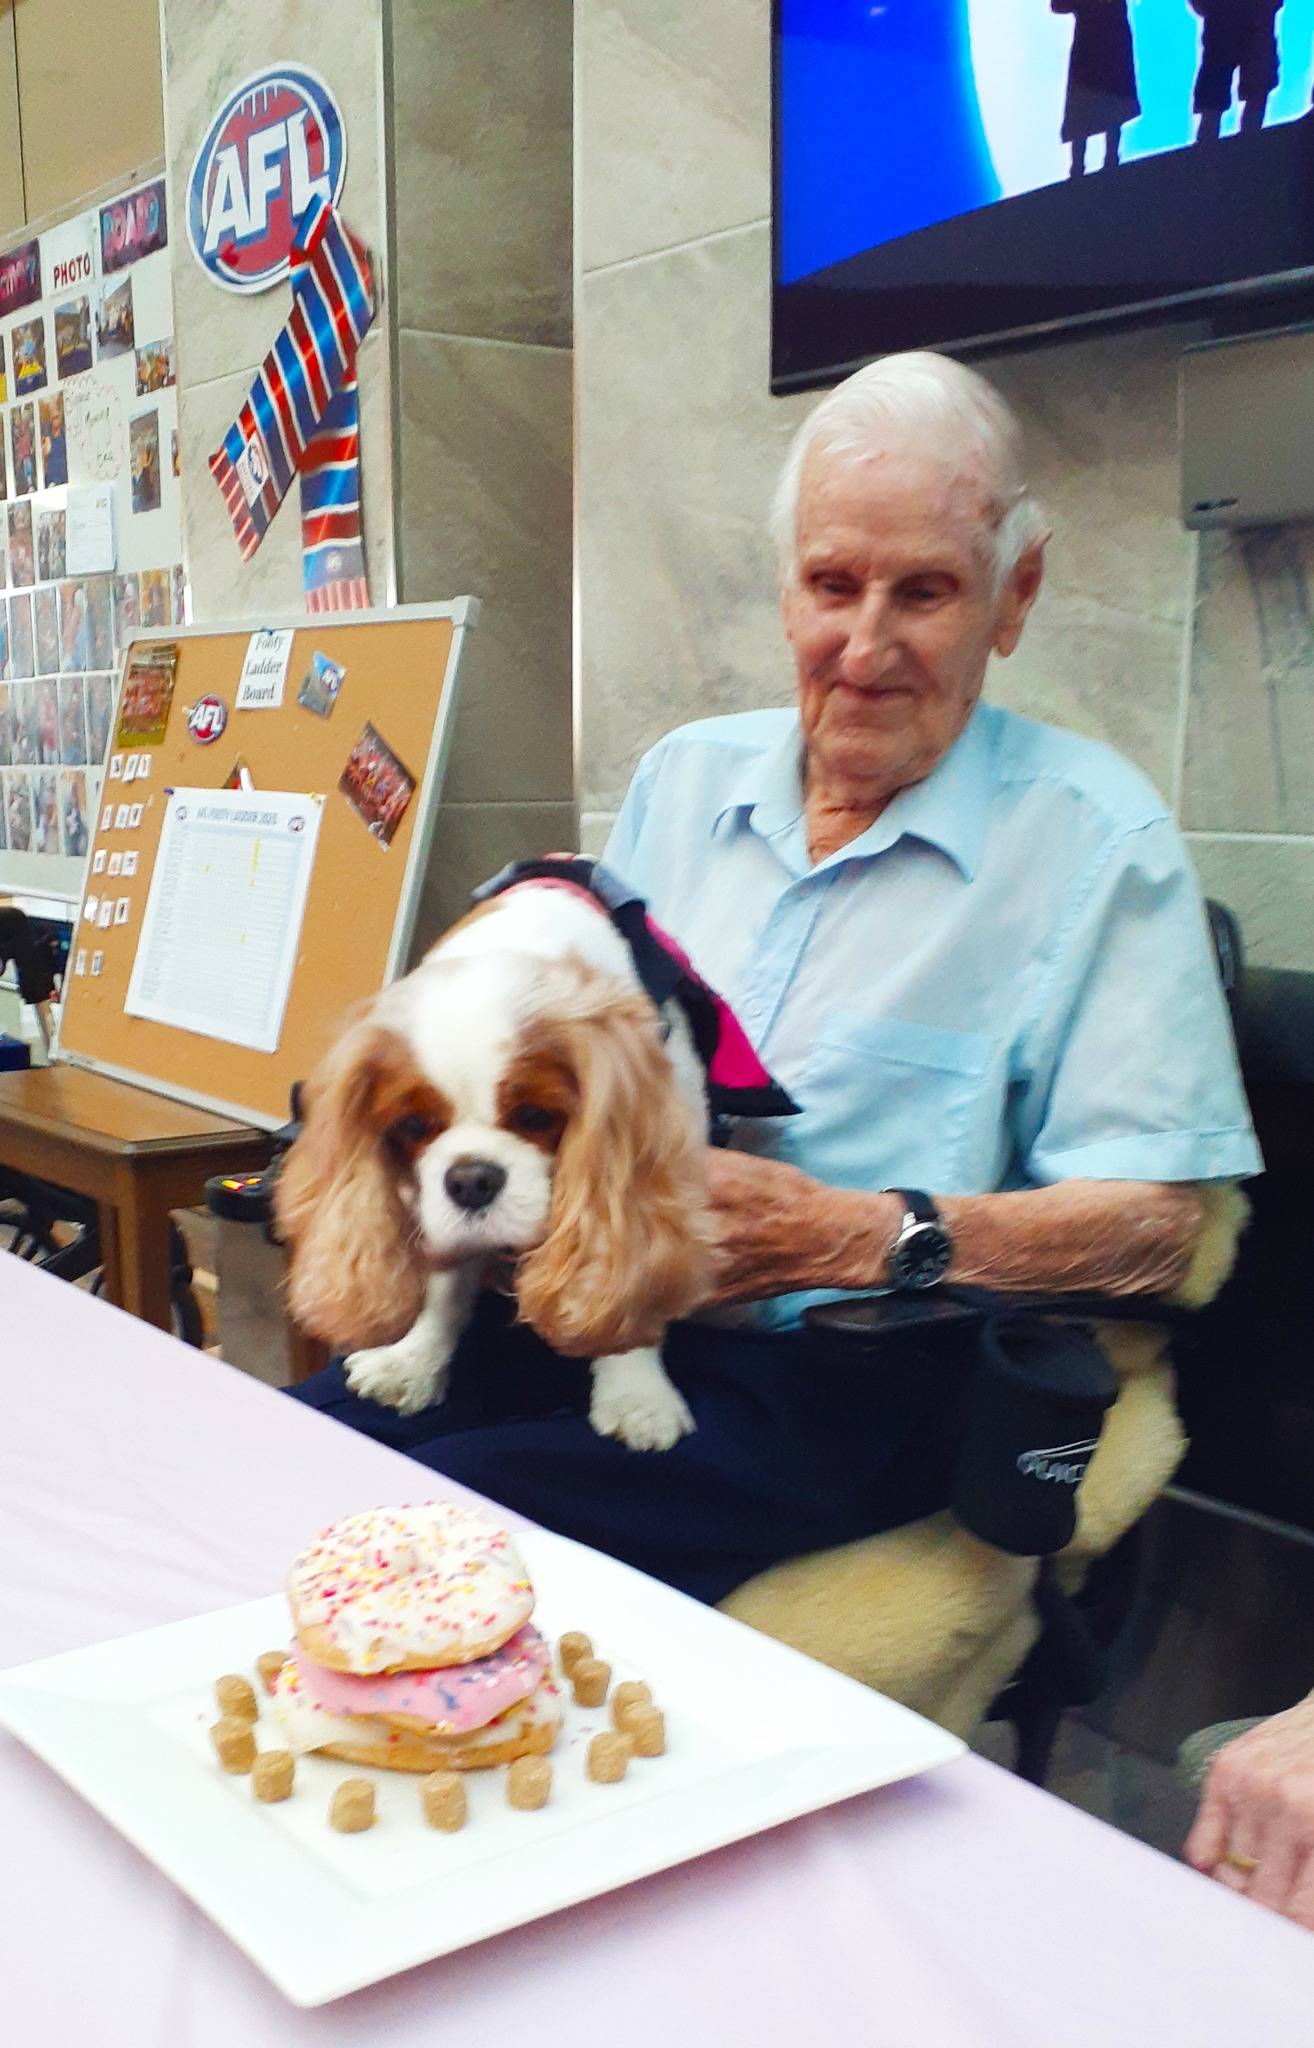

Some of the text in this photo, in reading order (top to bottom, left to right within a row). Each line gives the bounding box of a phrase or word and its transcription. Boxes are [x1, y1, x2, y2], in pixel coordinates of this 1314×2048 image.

[203, 107, 331, 252] AFL
[53, 252, 91, 288] PHOTO
[255, 635, 285, 651] Footy
[246, 657, 282, 675] Ladder
[243, 682, 275, 700] Board
[189, 702, 222, 731] AFL
